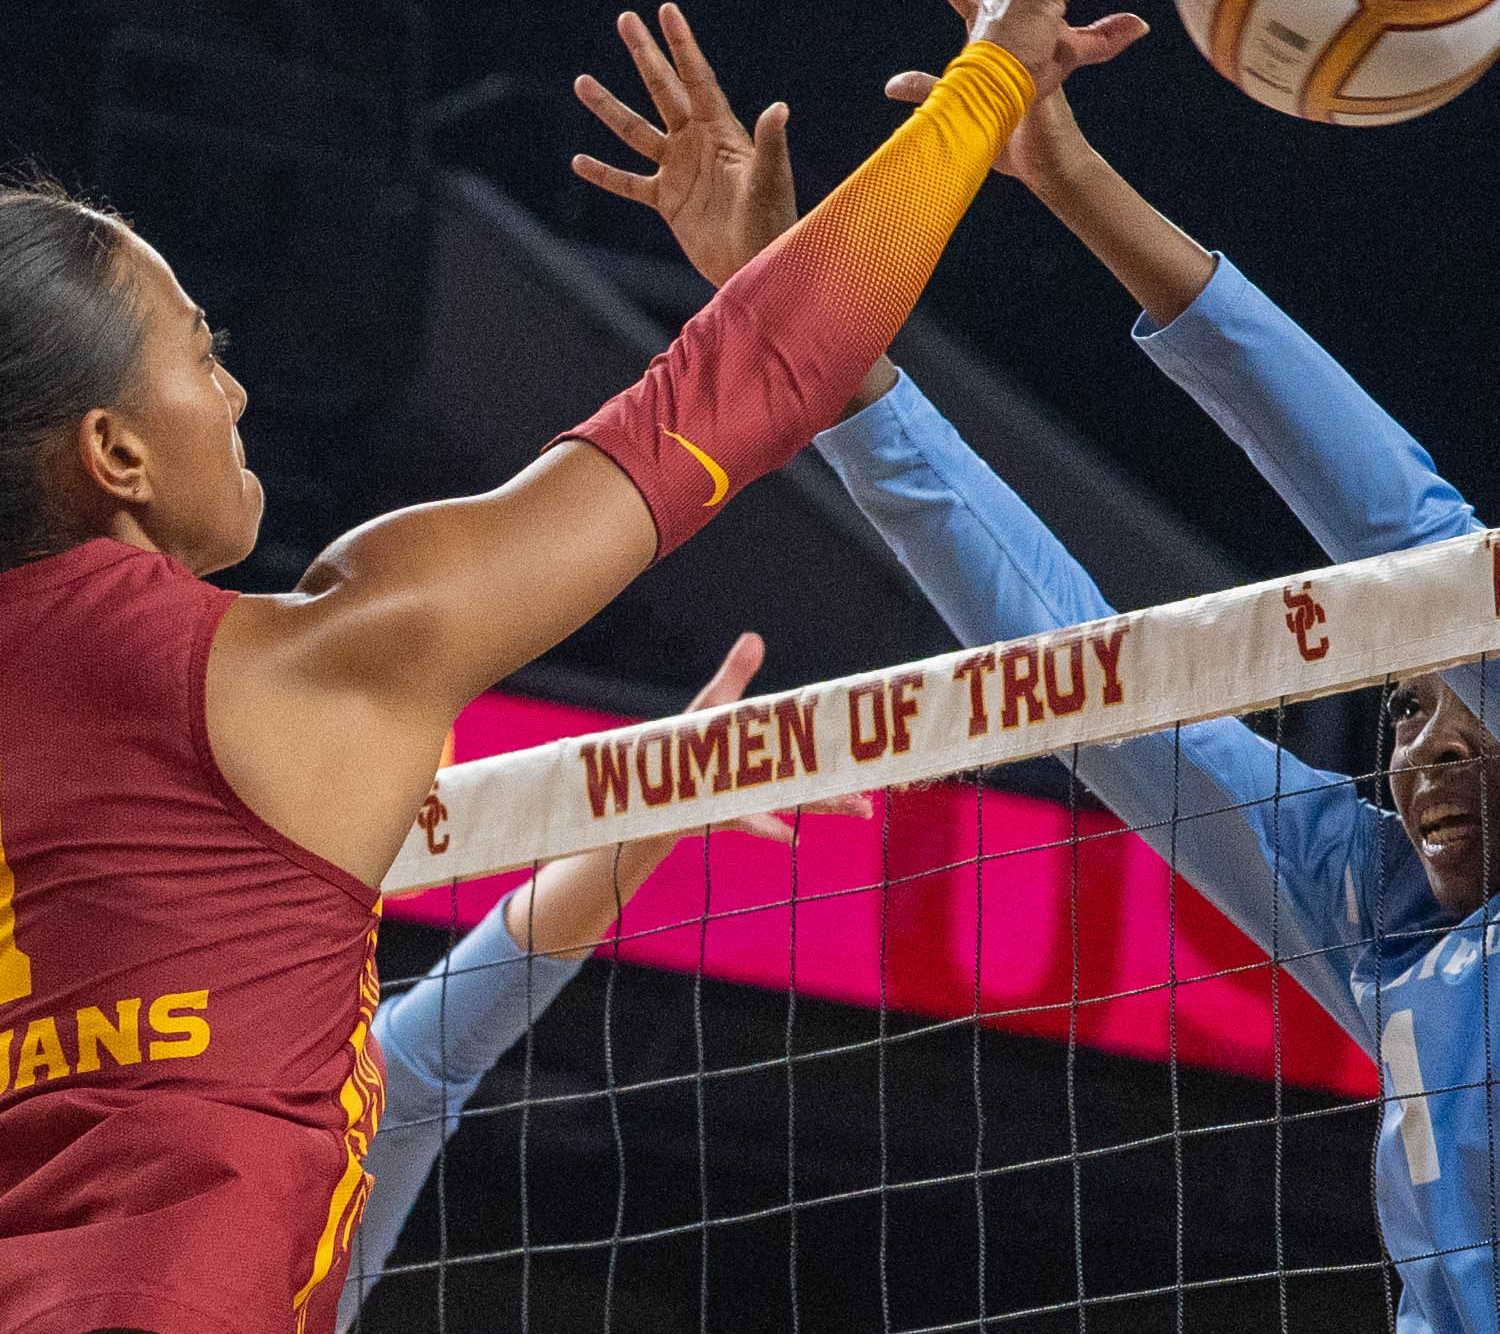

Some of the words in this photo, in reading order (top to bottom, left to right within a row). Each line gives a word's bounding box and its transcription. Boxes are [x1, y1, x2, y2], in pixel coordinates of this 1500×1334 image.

[580, 691, 820, 819] WOMEN
[848, 671, 924, 764] OF
[954, 624, 1130, 737] TROY
